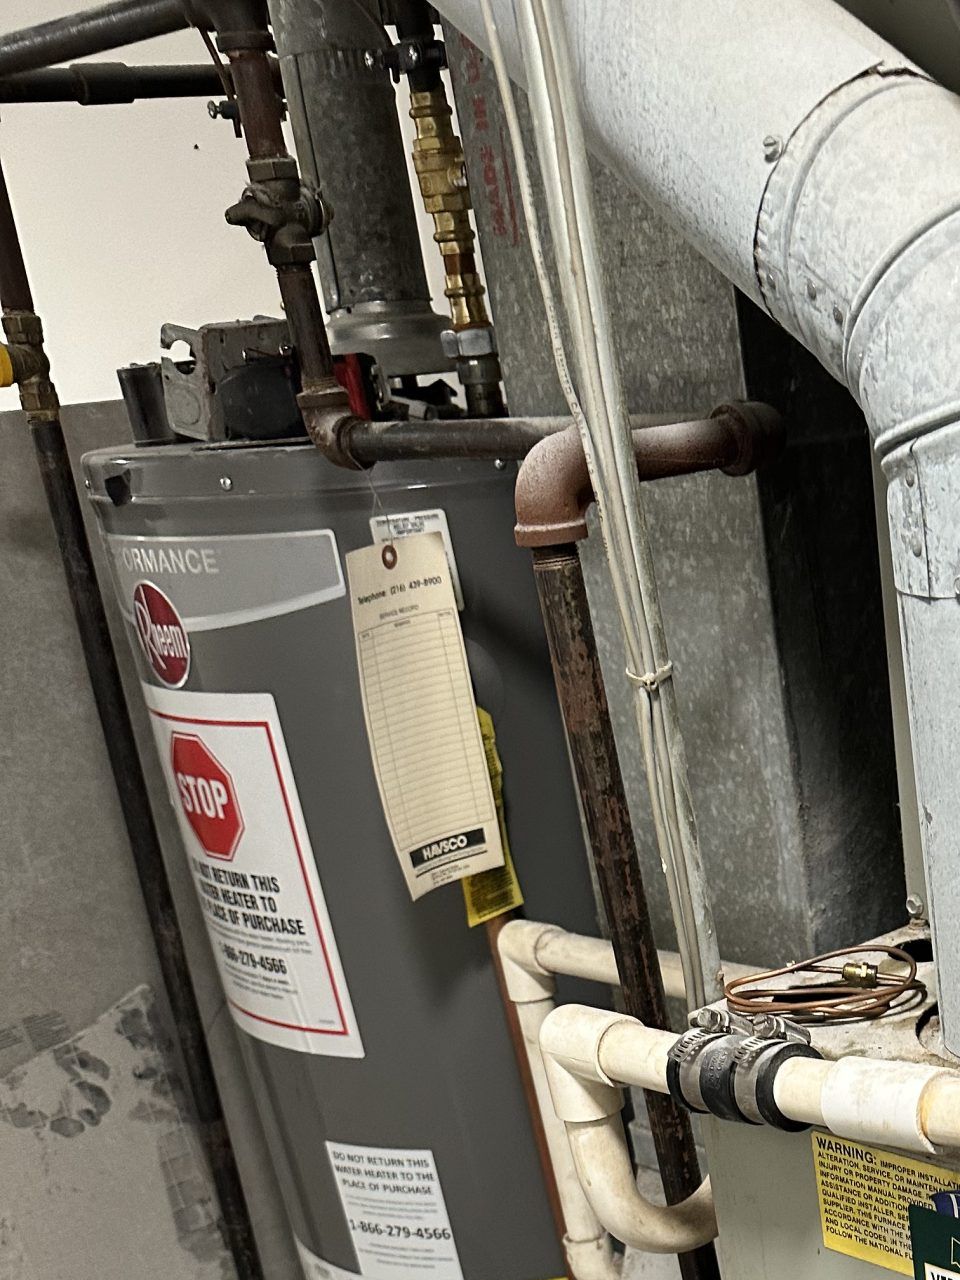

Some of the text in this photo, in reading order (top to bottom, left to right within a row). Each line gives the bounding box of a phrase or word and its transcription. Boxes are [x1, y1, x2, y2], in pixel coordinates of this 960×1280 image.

[134, 585, 189, 670] Rheem
[177, 772, 228, 820] STOP
[212, 867, 250, 889] RETURN
[250, 872, 280, 894] THIS
[221, 889, 259, 911] HEATER
[260, 896, 278, 913] TO
[242, 912, 306, 935] PURCHASE
[333, 1151, 430, 1169] DO NOT RETURN THIS
[816, 1136, 878, 1165] WARNING:
[880, 1160, 916, 1177] IMPROPER
[335, 1164, 435, 1182] WATER HEATER TO THE
[819, 1160, 842, 1173] INJURY
[843, 1168, 854, 1177] OR
[855, 1172, 891, 1188] PROPERTY
[820, 1170, 866, 1190] INFORMATION
[867, 1184, 897, 1200] MANUAL
[894, 1174, 905, 1183] OR
[342, 1178, 433, 1195] PLACE OF PURCHASE
[821, 1180, 862, 1198] ASSISTANCE
[863, 1192, 873, 1201] OR
[822, 1189, 857, 1205] QUALIFIED
[349, 1218, 452, 1241] 1-866-279-4566
[824, 1207, 870, 1228] ACCORDANCE
[872, 1223, 889, 1235] WITH
[891, 1229, 904, 1239] THE
[825, 1216, 839, 1227] AND
[840, 1221, 863, 1236] LOCAL
[890, 1238, 898, 1247] IN
[857, 1208, 872, 1219] THIS
[873, 1214, 906, 1231] FURNACE
[825, 1225, 853, 1241] FOLLOW
[854, 1234, 868, 1246] THE
[868, 1240, 904, 1258] NATIONAL
